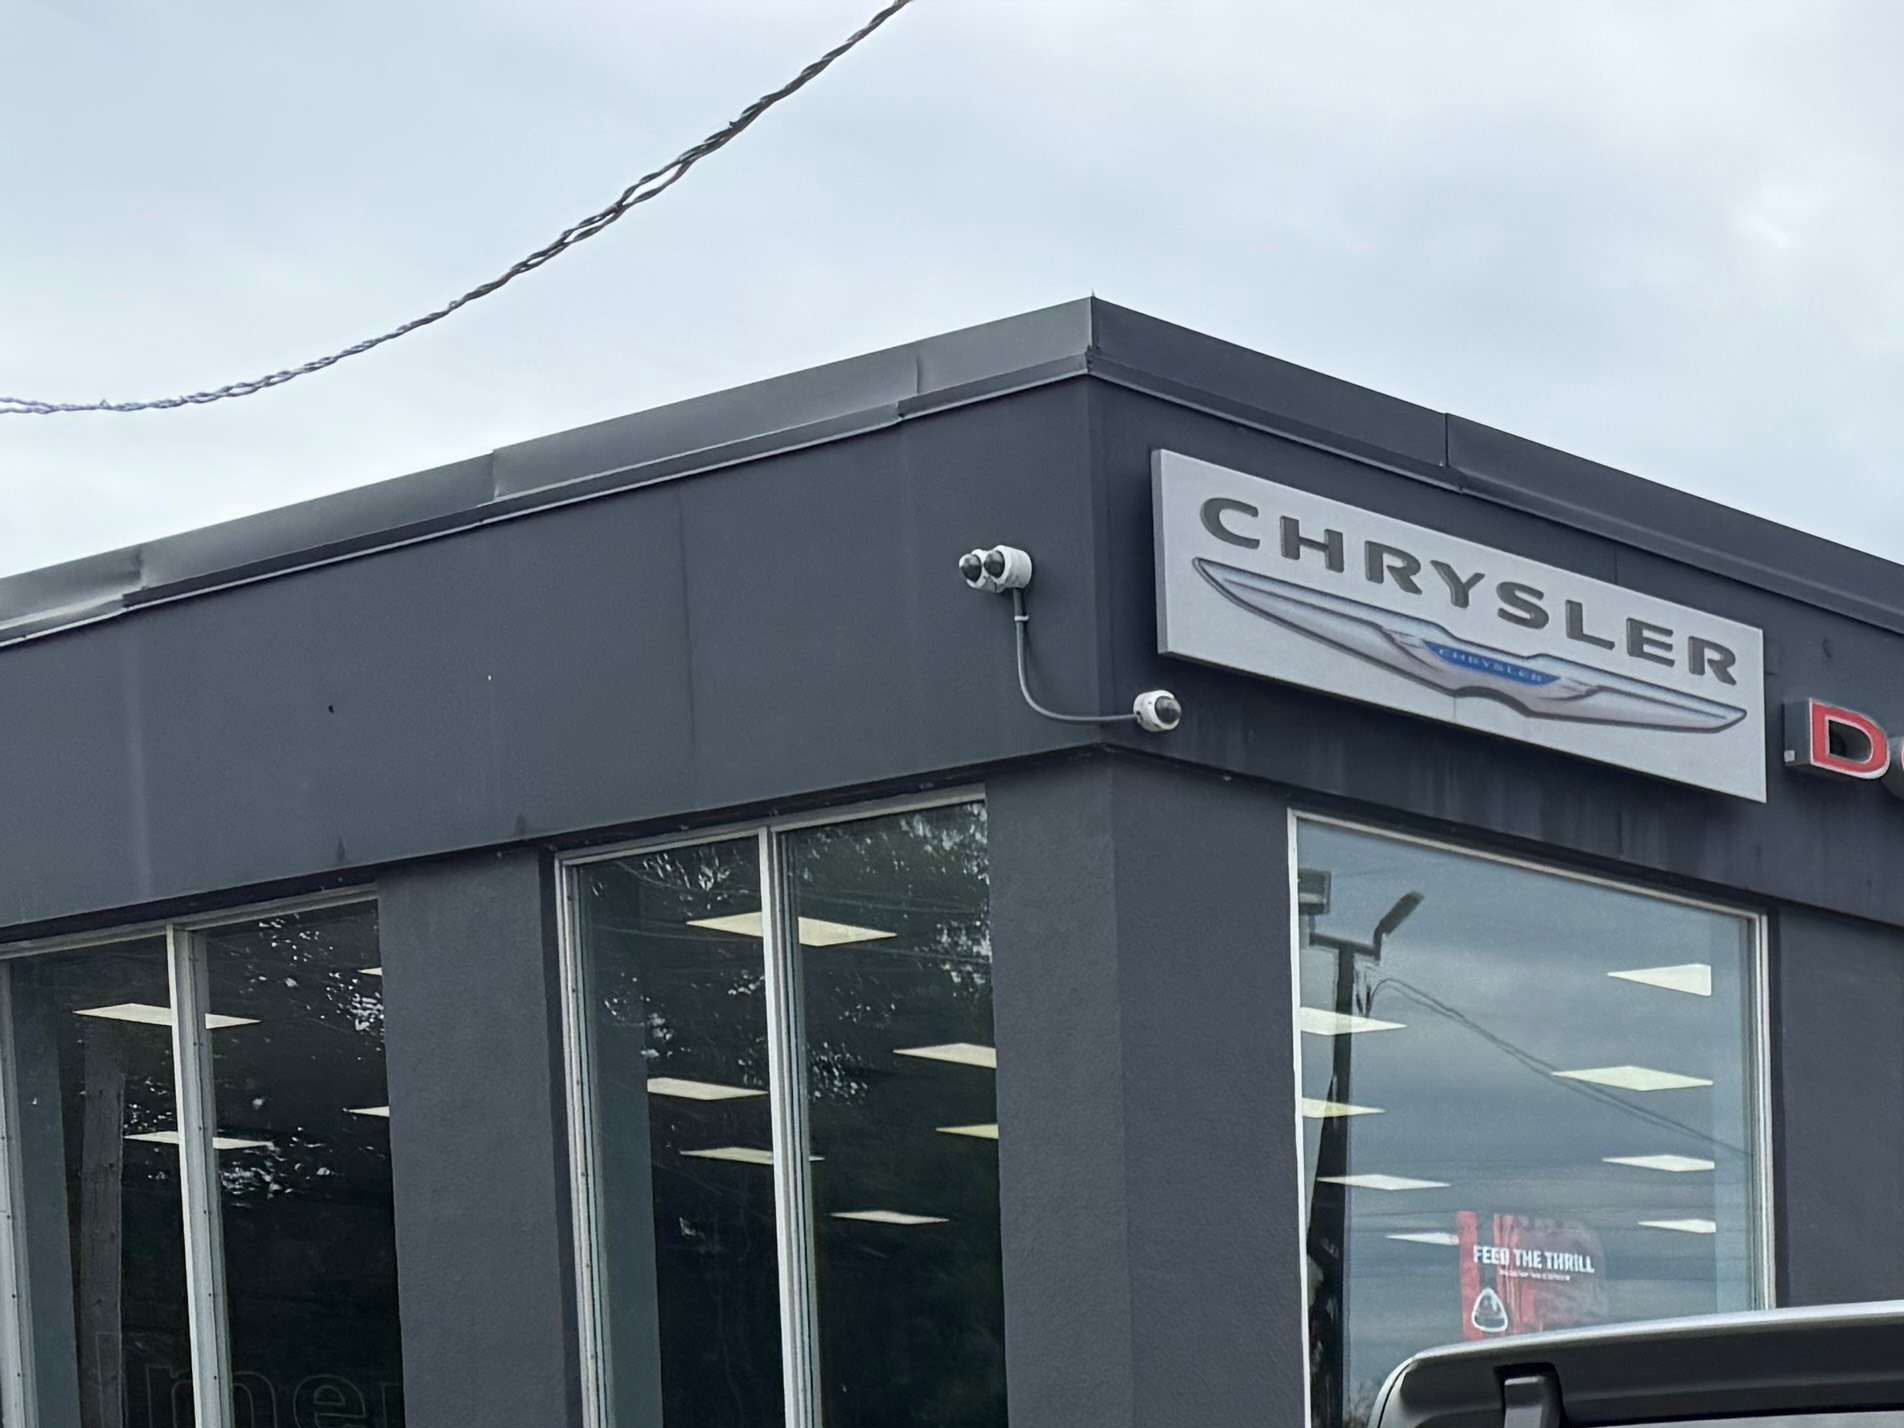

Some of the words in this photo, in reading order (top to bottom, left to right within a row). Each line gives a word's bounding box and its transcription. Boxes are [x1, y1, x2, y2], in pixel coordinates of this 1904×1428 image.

[1199, 496, 1738, 687] CHRYSLER
[1473, 1245, 1510, 1266] FEED
[1513, 1249, 1543, 1269] THE
[1545, 1252, 1596, 1274] THRILL
